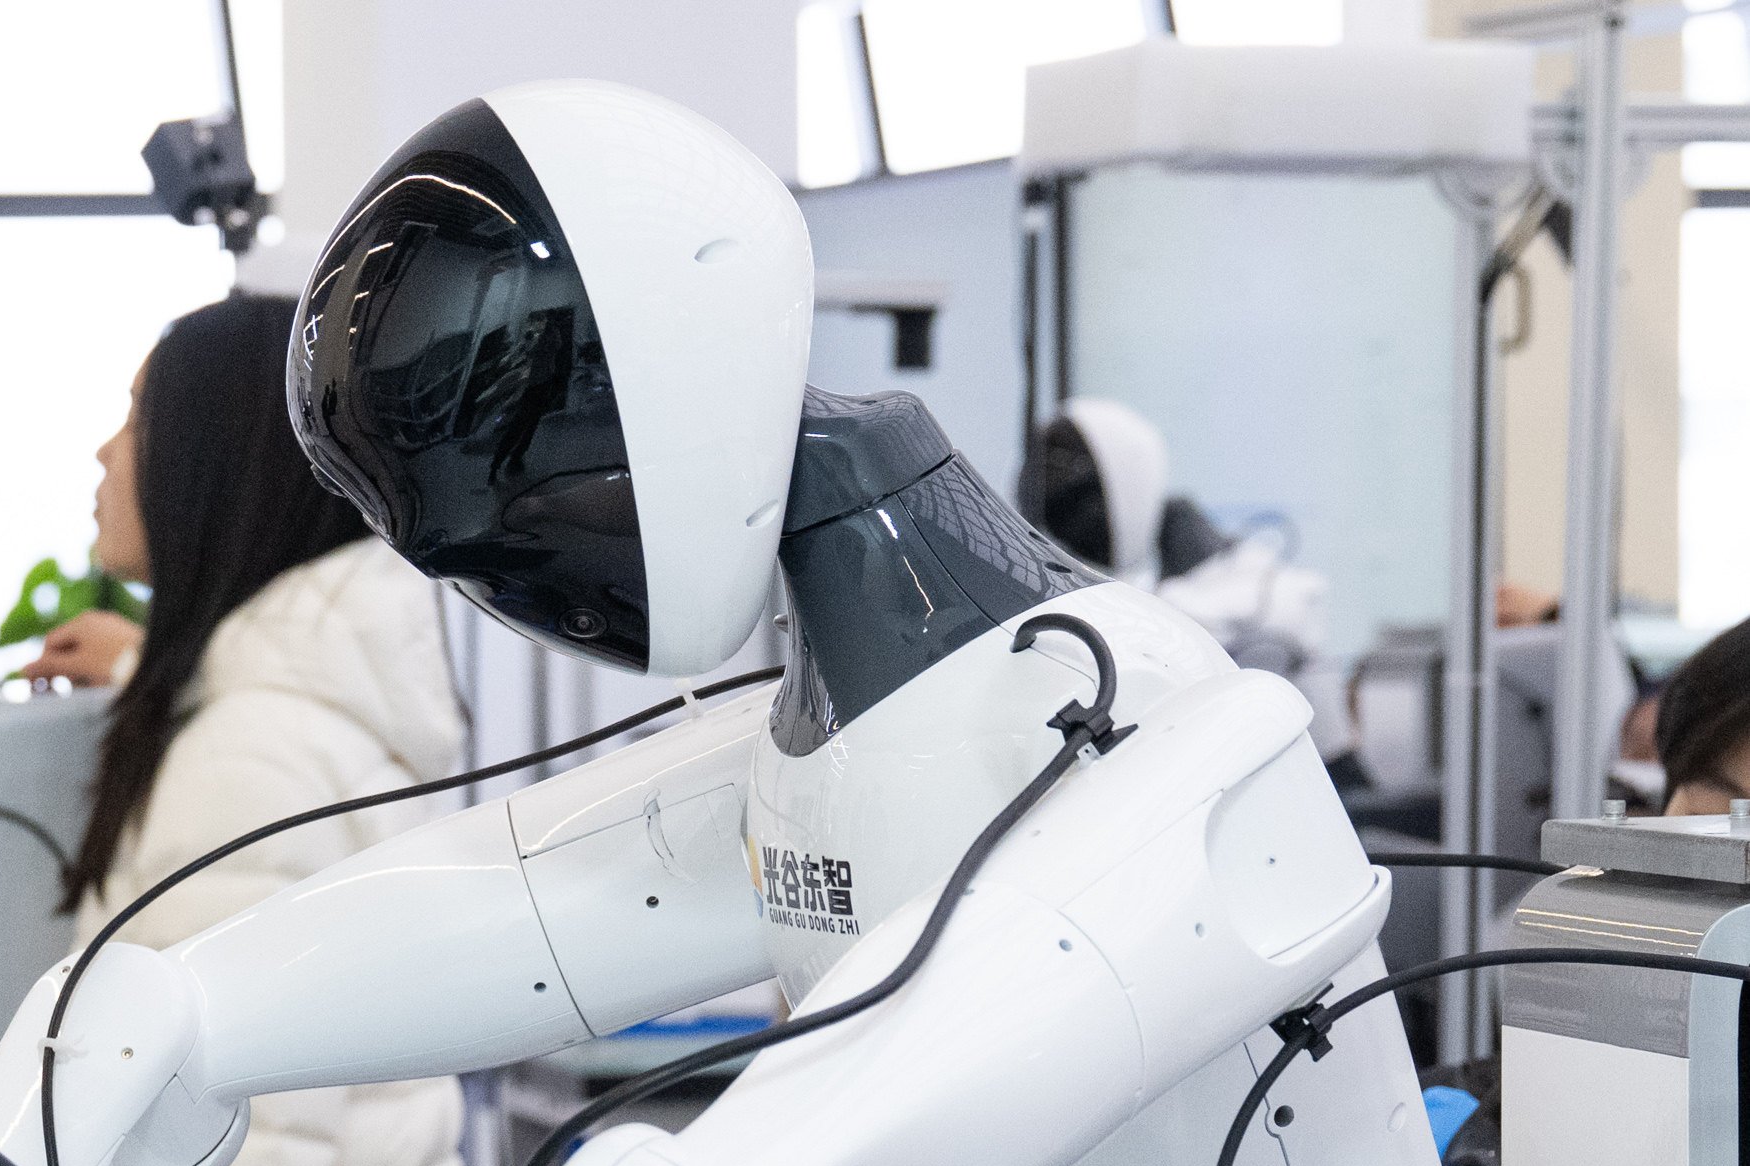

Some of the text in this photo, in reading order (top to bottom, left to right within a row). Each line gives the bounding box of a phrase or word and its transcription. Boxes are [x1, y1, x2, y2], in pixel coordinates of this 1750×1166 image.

[762, 846, 853, 916] 光谷东智
[769, 907, 860, 936] GUANG GU DONG ZHI
